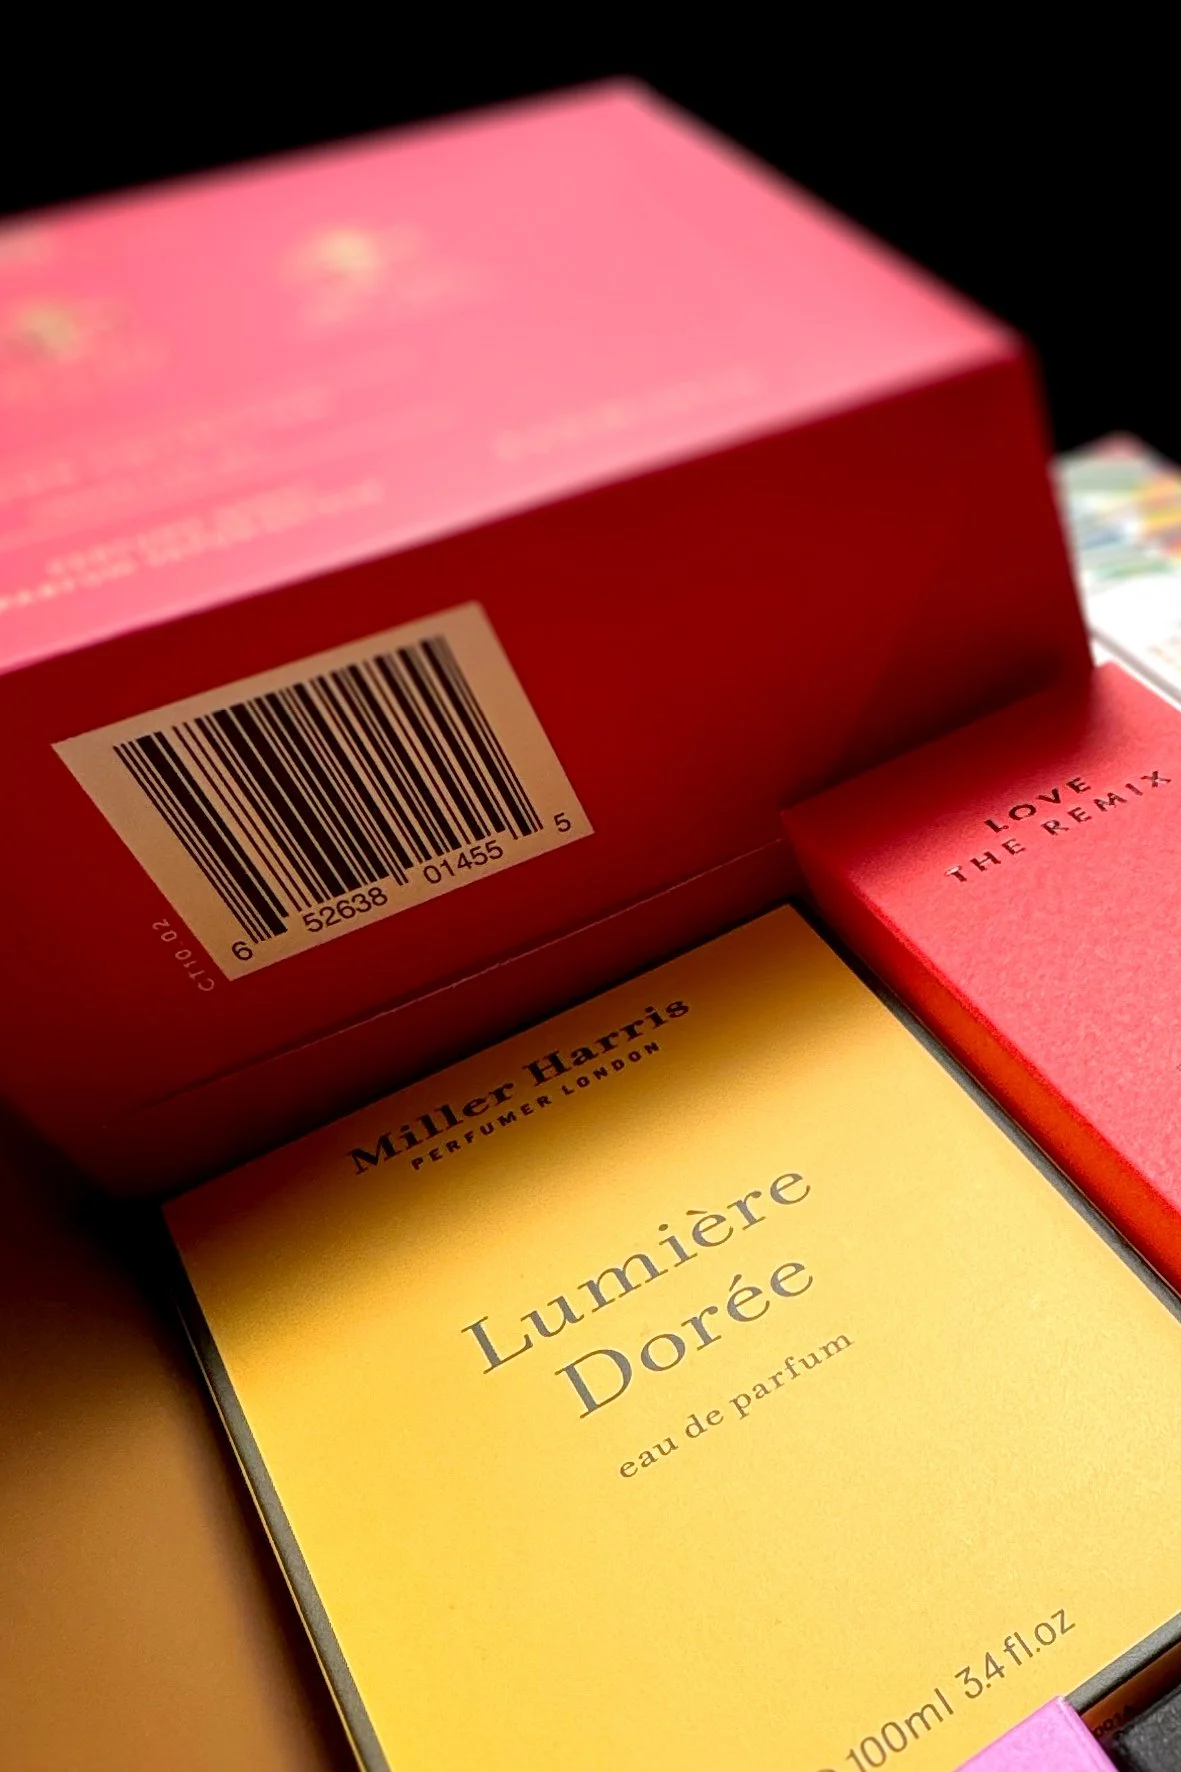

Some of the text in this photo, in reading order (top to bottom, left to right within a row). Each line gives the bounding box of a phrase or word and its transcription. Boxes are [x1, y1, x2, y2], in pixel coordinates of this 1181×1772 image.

[945, 770, 1171, 882] THE REMIX
[984, 777, 1091, 833] LOVE
[231, 812, 571, 962] 6 52638 01455 5
[348, 1000, 689, 1176] Miller Harris
[411, 1041, 660, 1170] PERFUMER LONDON
[460, 1172, 811, 1374] Lumière
[554, 1261, 813, 1419] Dorée
[619, 1331, 855, 1479] eau de parfum
[845, 1687, 955, 1772] 100ml
